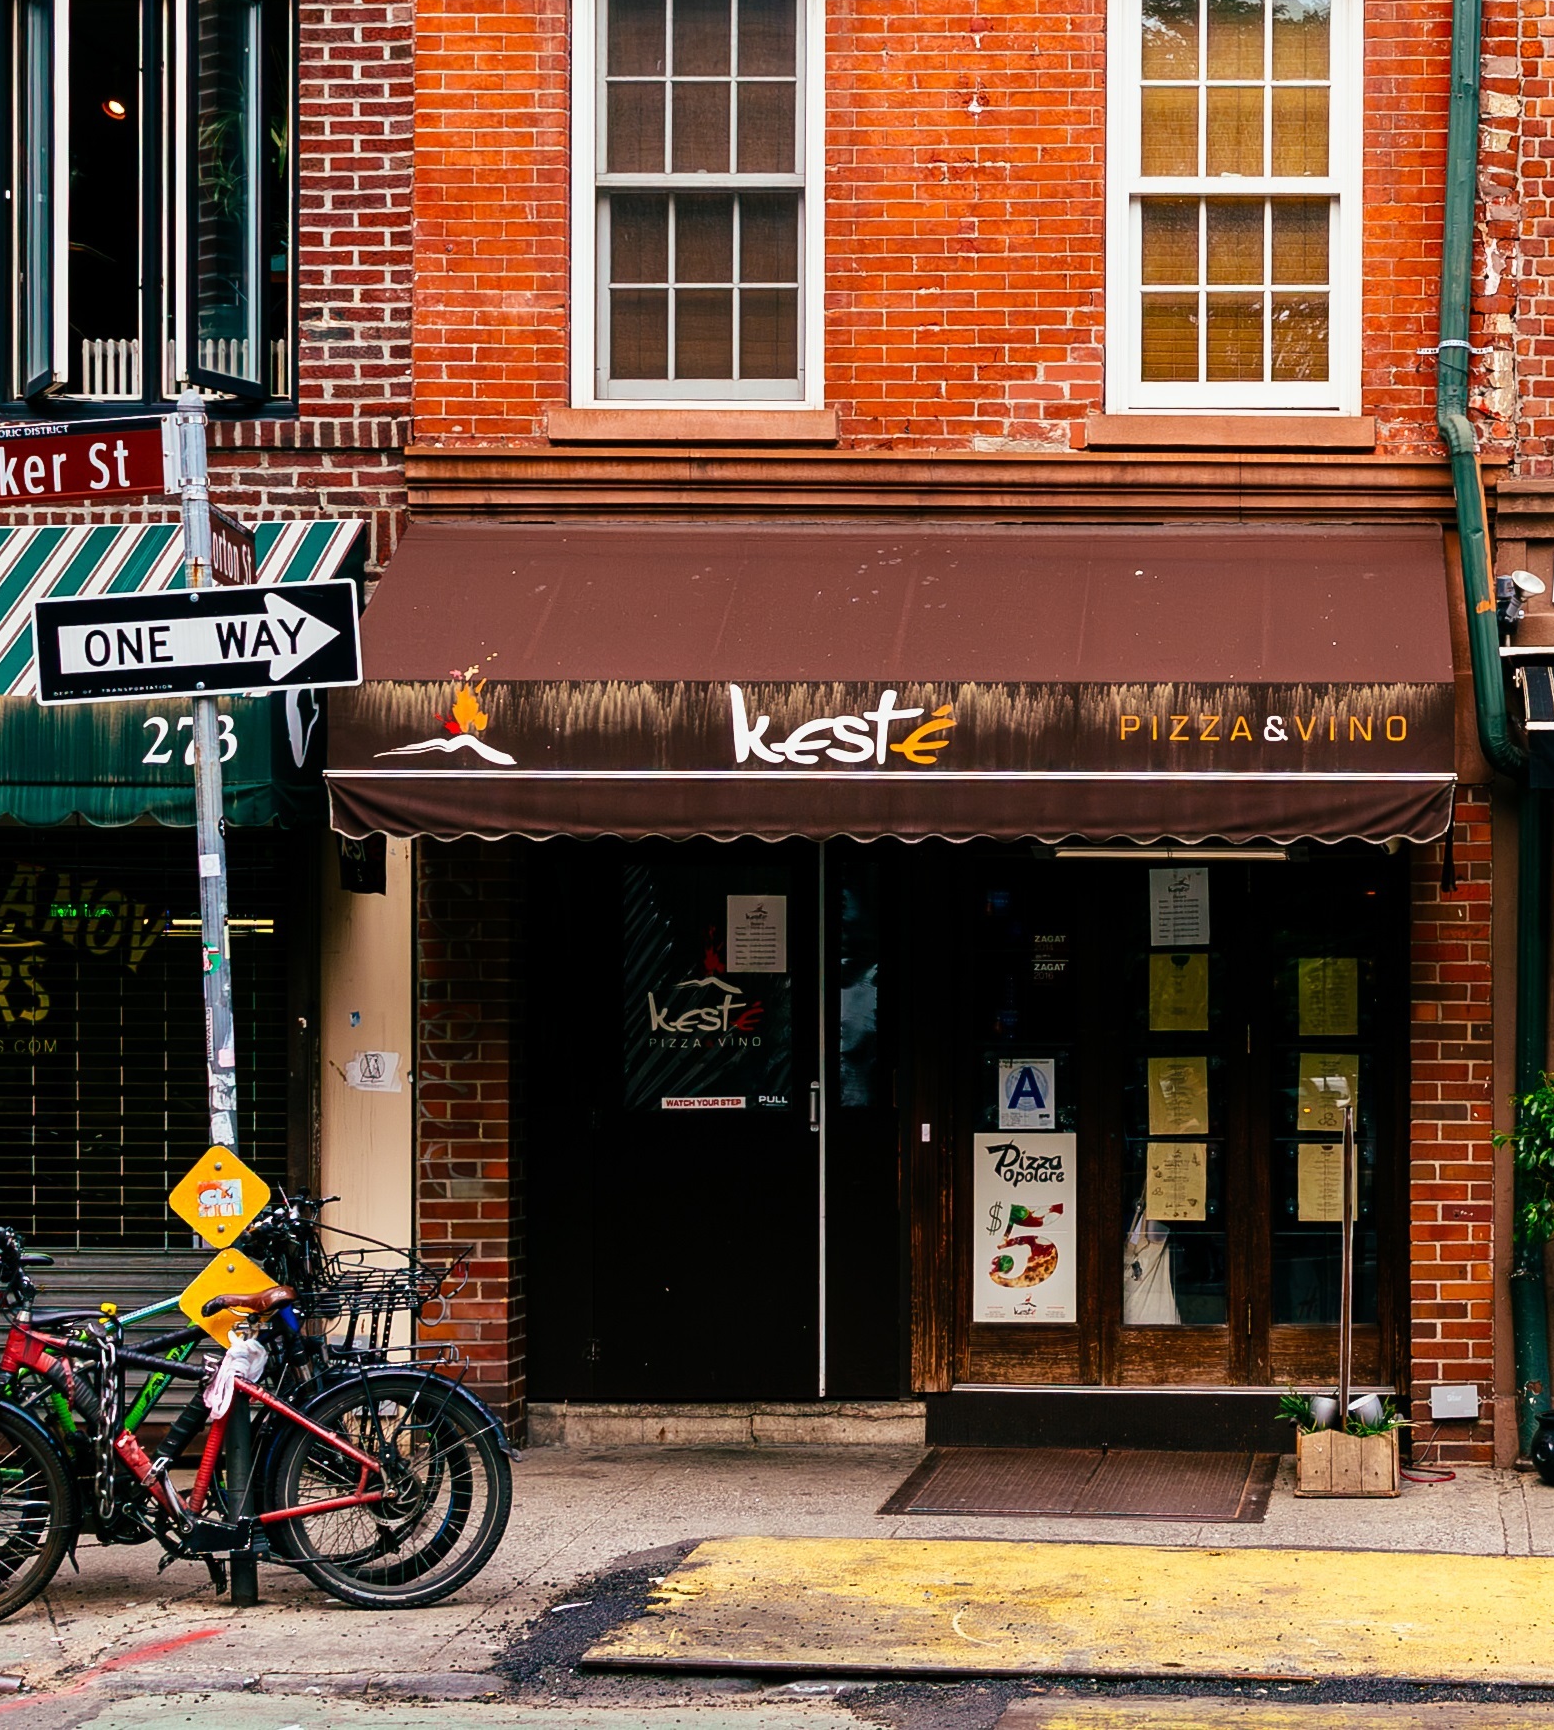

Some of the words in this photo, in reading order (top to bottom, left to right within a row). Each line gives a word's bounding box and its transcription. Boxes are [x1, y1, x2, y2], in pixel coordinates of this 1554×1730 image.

[24, 424, 69, 437] DISTRICT
[89, 439, 131, 490] St
[212, 529, 240, 583] orton
[84, 625, 174, 667] ONE
[215, 617, 307, 660] WAY
[1034, 935, 1067, 943] ZAGAT
[1033, 963, 1066, 971] ZAGAT
[649, 1038, 702, 1049] PIZZA
[718, 1036, 762, 1047] VINO
[1007, 1066, 1046, 1109] A
[666, 1098, 696, 1107] WATCH
[697, 1098, 719, 1107] YOUR
[720, 1097, 742, 1106] STEP
[758, 1095, 788, 1104] PULL
